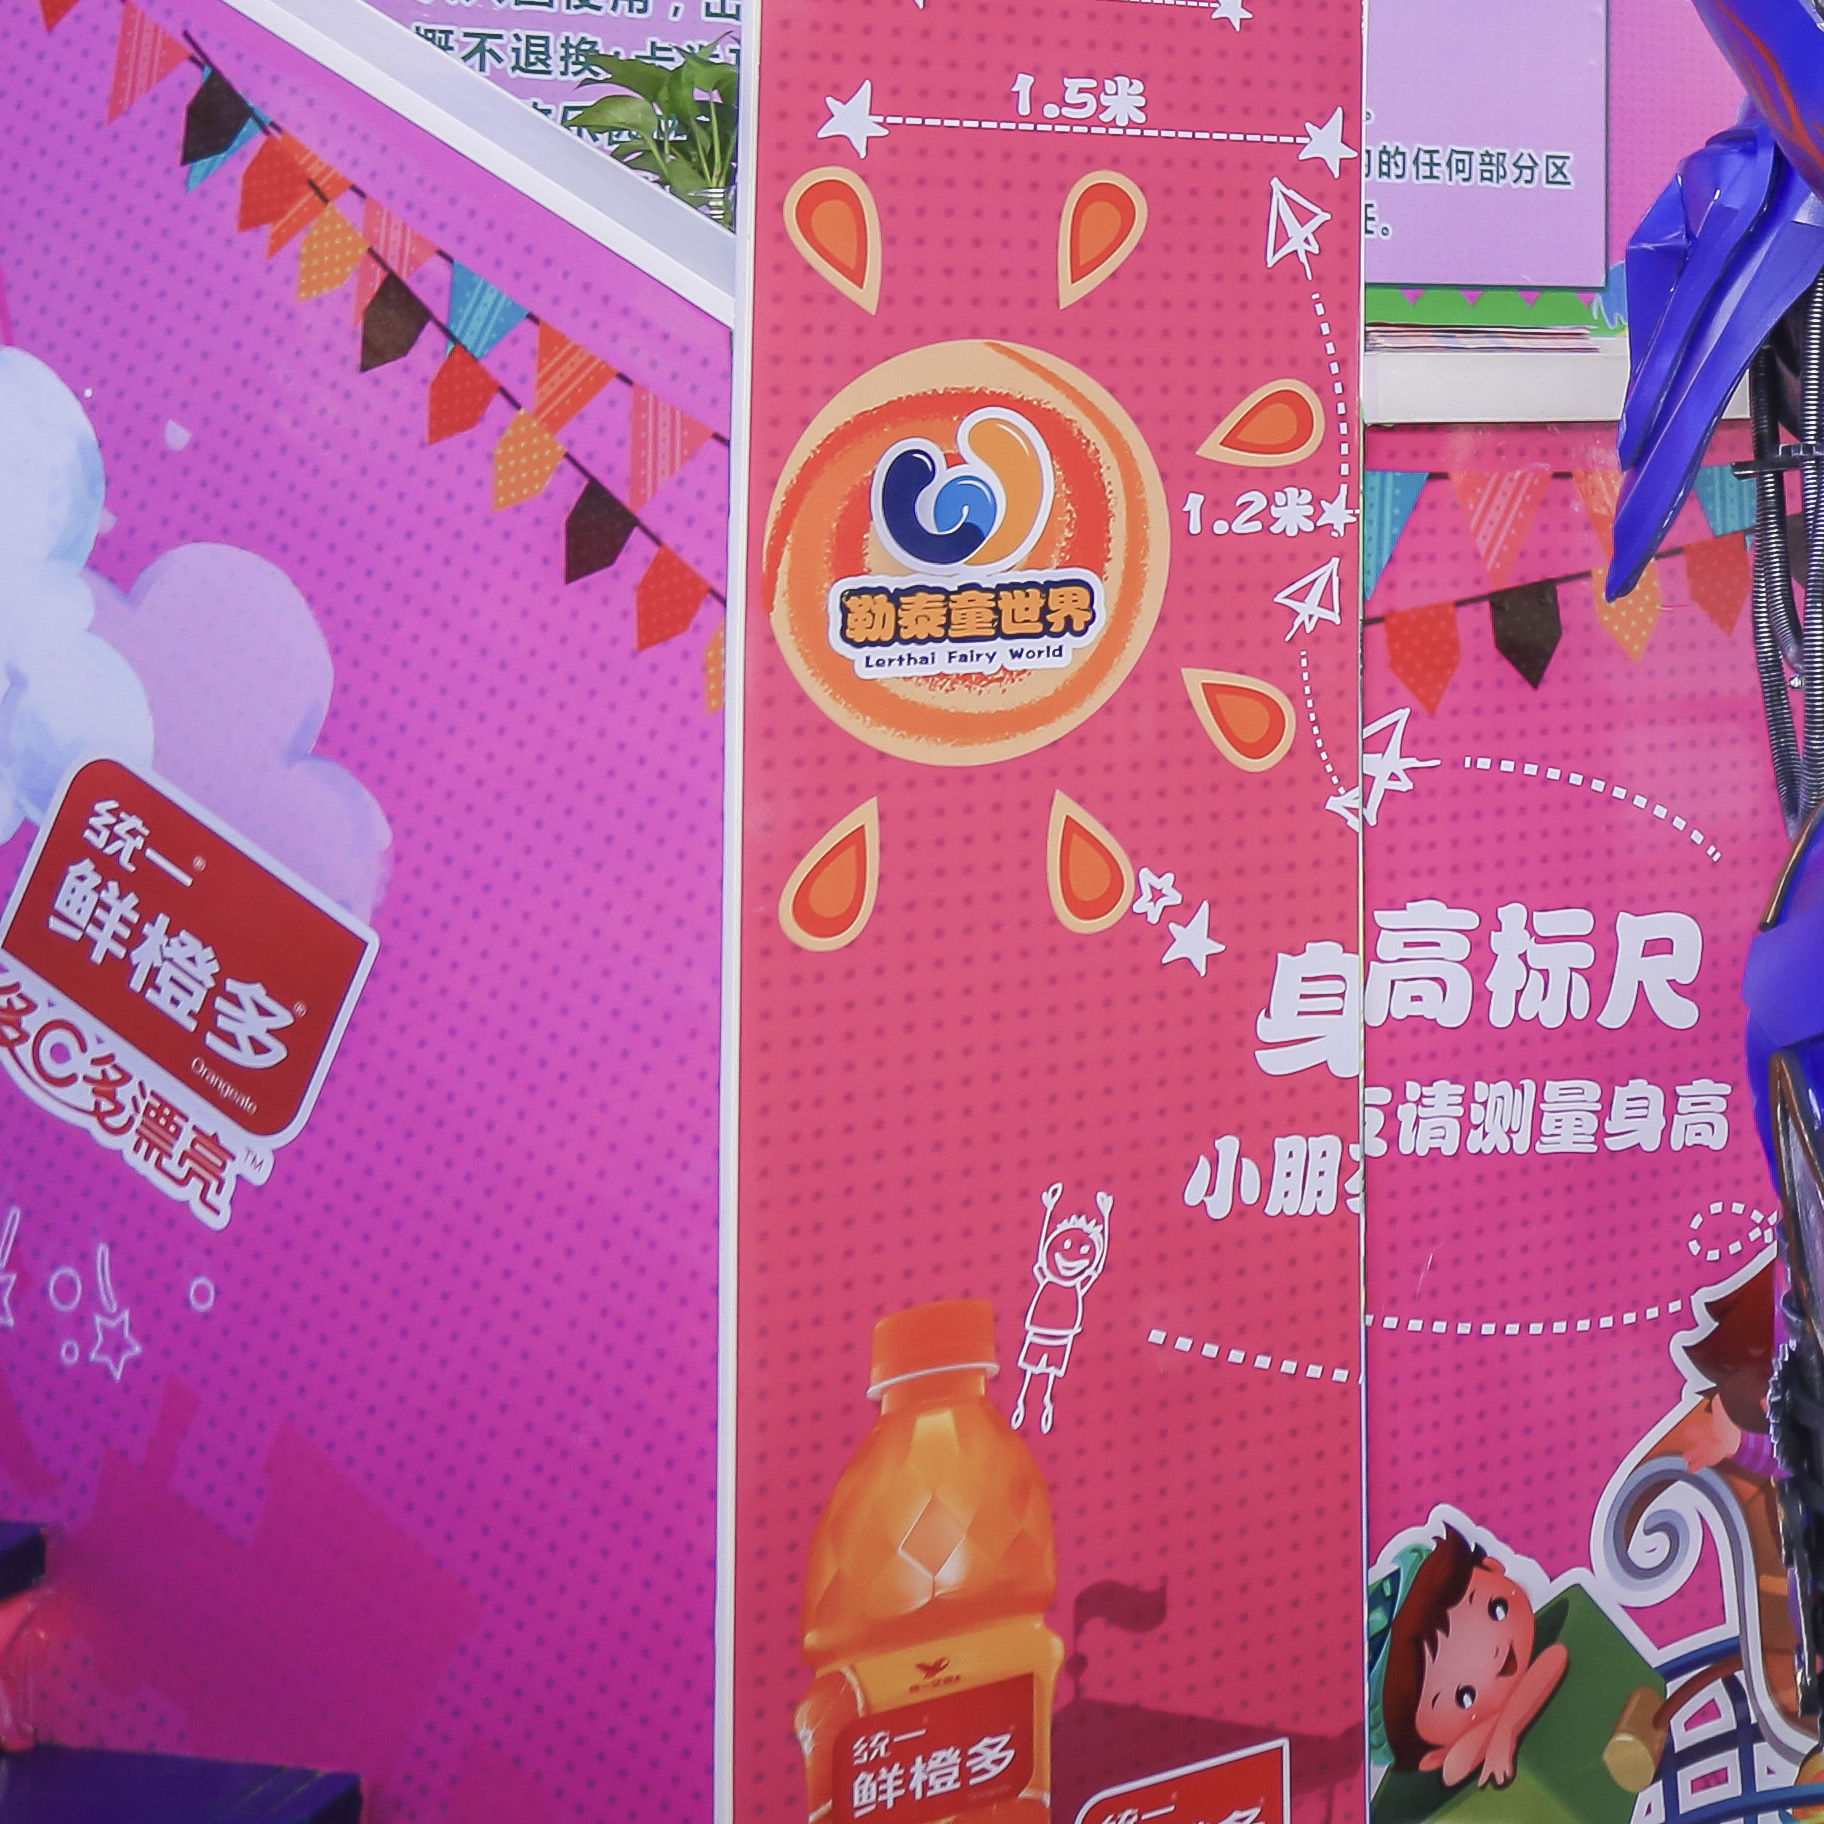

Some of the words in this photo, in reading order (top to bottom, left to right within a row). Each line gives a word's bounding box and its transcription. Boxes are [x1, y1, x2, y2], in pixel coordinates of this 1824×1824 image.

[1012, 73, 1147, 125] 1.5米
[1184, 487, 1318, 537] 1.2米
[844, 582, 1094, 644] 勒泰童世界
[865, 652, 936, 669] Lerthai
[948, 649, 997, 665] Fairy
[1008, 644, 1064, 661] World
[82, 797, 193, 888] 统一
[47, 857, 296, 1070] 鲜橙多
[1254, 899, 1702, 1078] 身高标尺
[852, 1728, 928, 1767] 统一
[852, 1732, 1017, 1819] 鲜橙多
